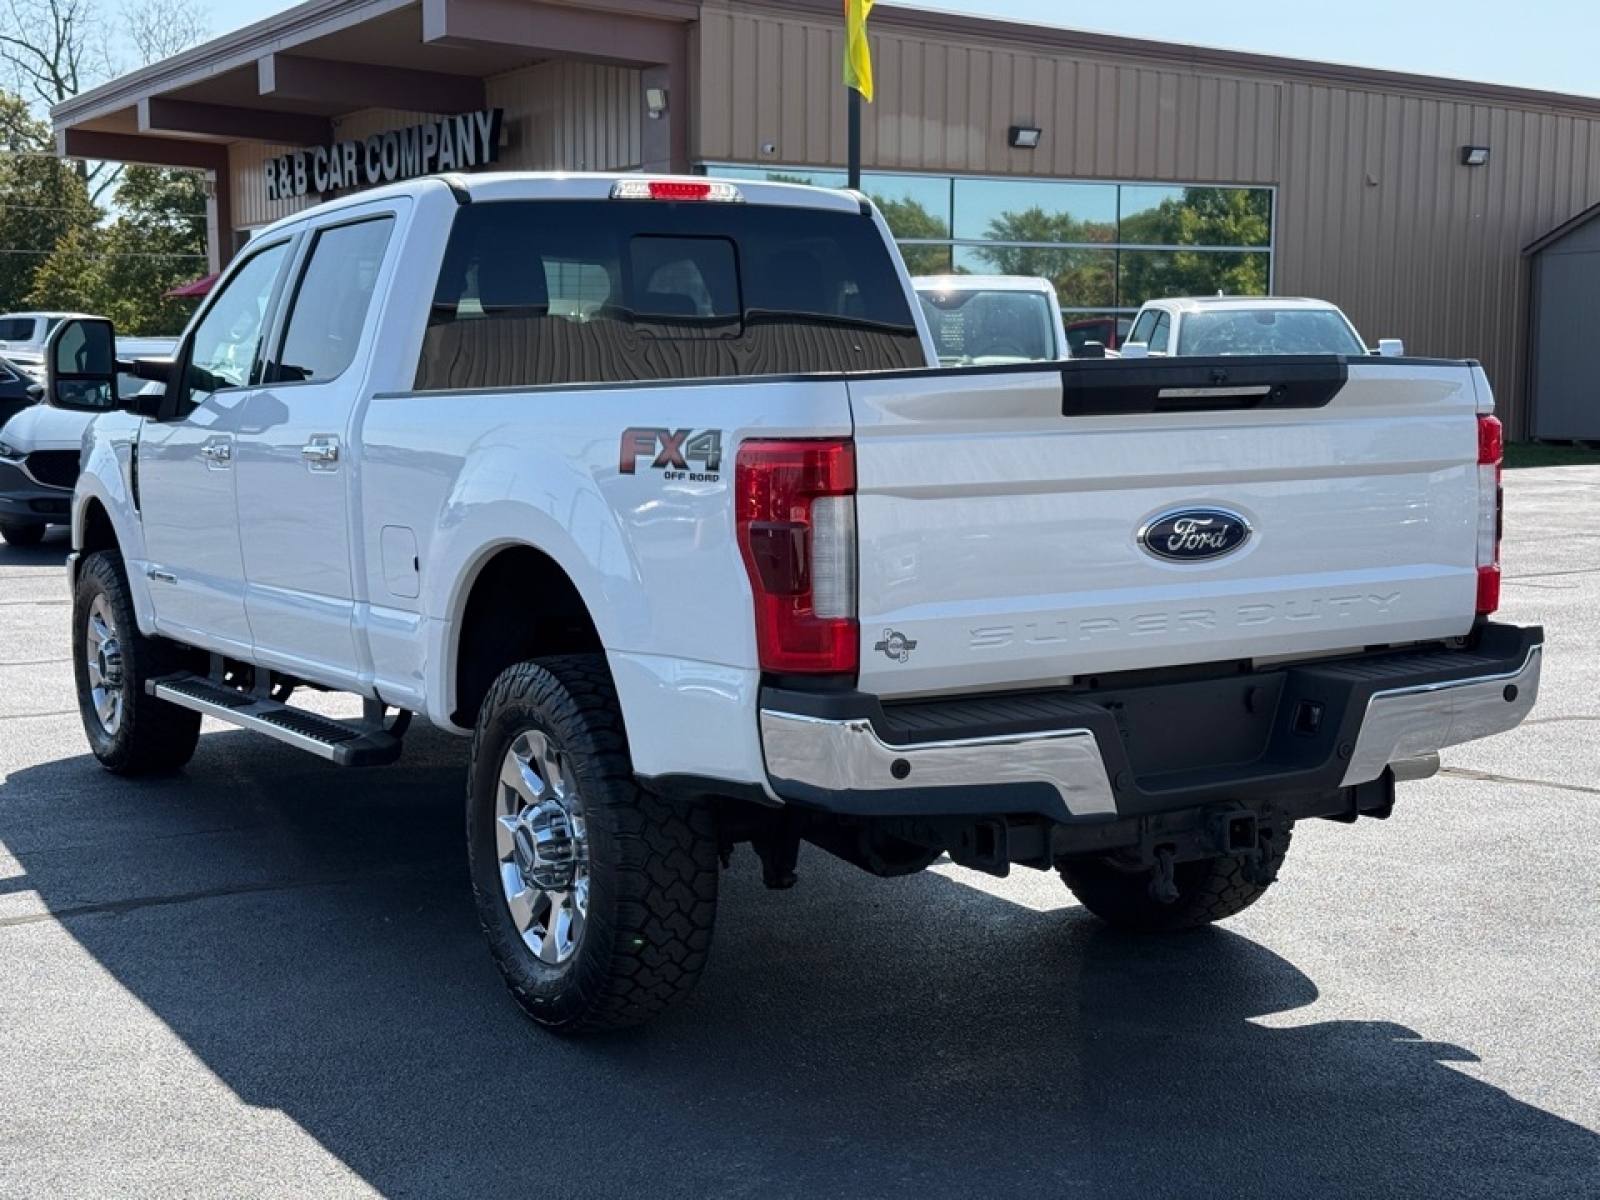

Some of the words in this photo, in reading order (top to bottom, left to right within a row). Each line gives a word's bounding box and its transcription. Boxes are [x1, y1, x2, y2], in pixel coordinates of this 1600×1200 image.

[264, 153, 308, 200] R&B
[313, 141, 358, 193] CAR
[364, 109, 495, 184] COMPANY
[619, 427, 722, 475] FX4
[664, 471, 685, 480] OFF
[690, 473, 719, 482] ROAD
[1168, 518, 1229, 551] Ford
[970, 609, 1216, 650] SUPER
[1237, 591, 1401, 626] DUTY
